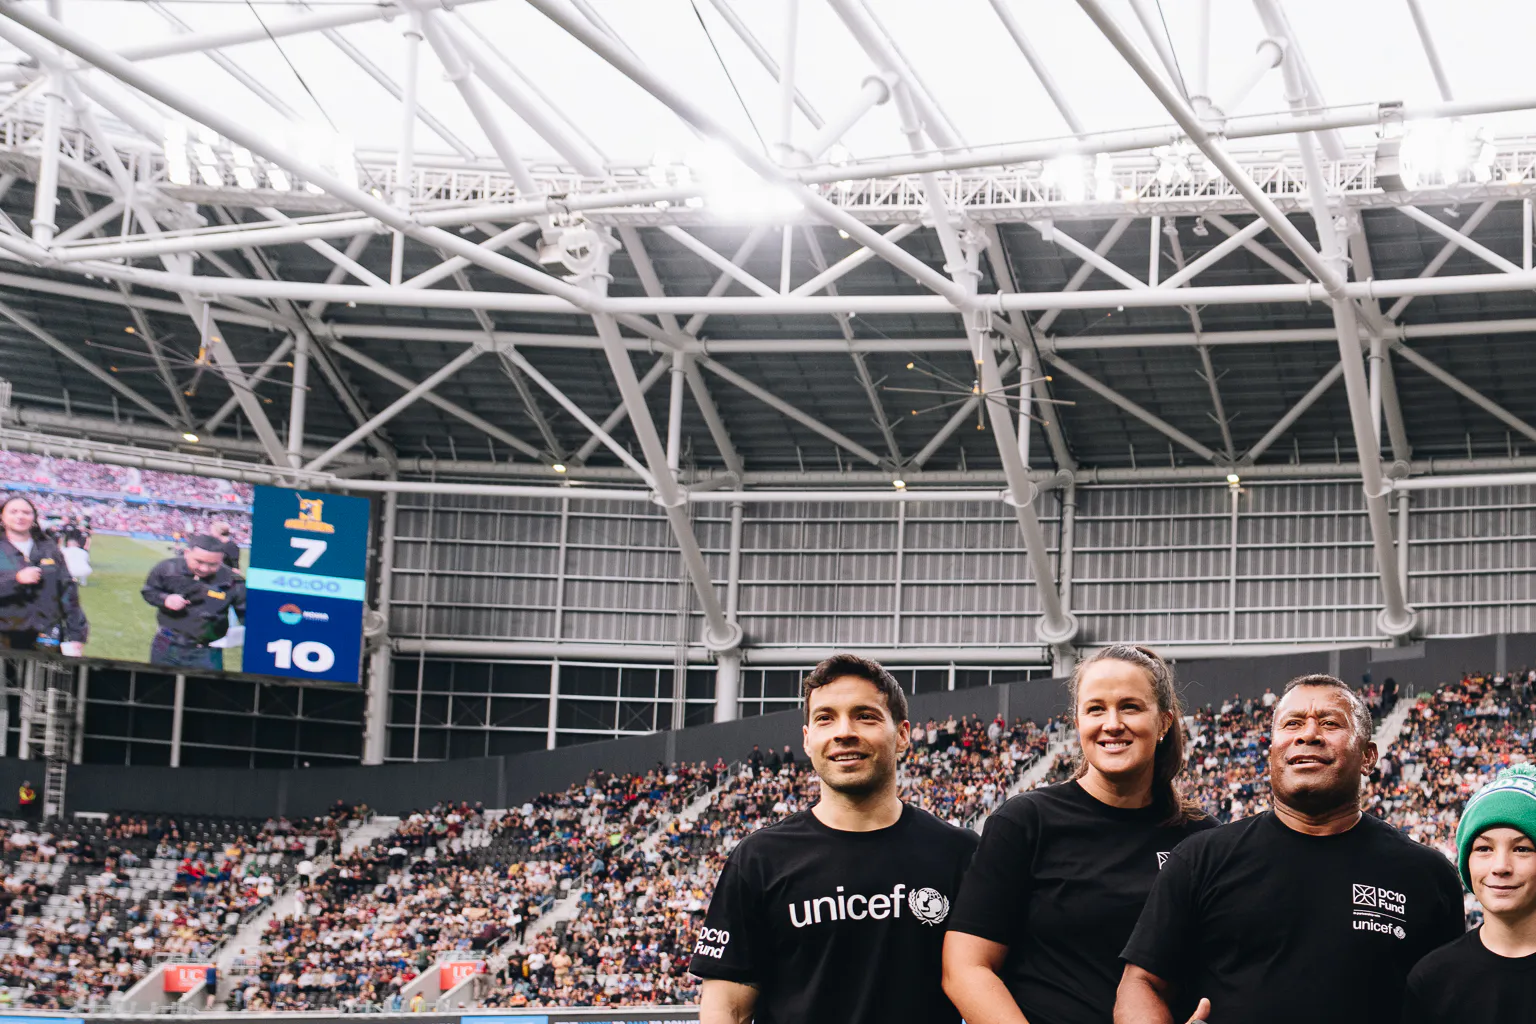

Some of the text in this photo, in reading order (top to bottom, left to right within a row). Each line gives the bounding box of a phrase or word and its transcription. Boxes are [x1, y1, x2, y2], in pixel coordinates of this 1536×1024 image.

[290, 536, 327, 568] 7
[272, 576, 340, 593] 40:00
[266, 639, 335, 673] 10
[1378, 887, 1406, 904] DC10
[788, 883, 906, 928] unicef
[1378, 898, 1405, 915] Fund
[1352, 918, 1393, 935] unicef
[700, 926, 730, 945] DC10
[693, 941, 725, 959] Fund
[180, 968, 203, 981] UC
[453, 965, 473, 979] UC
